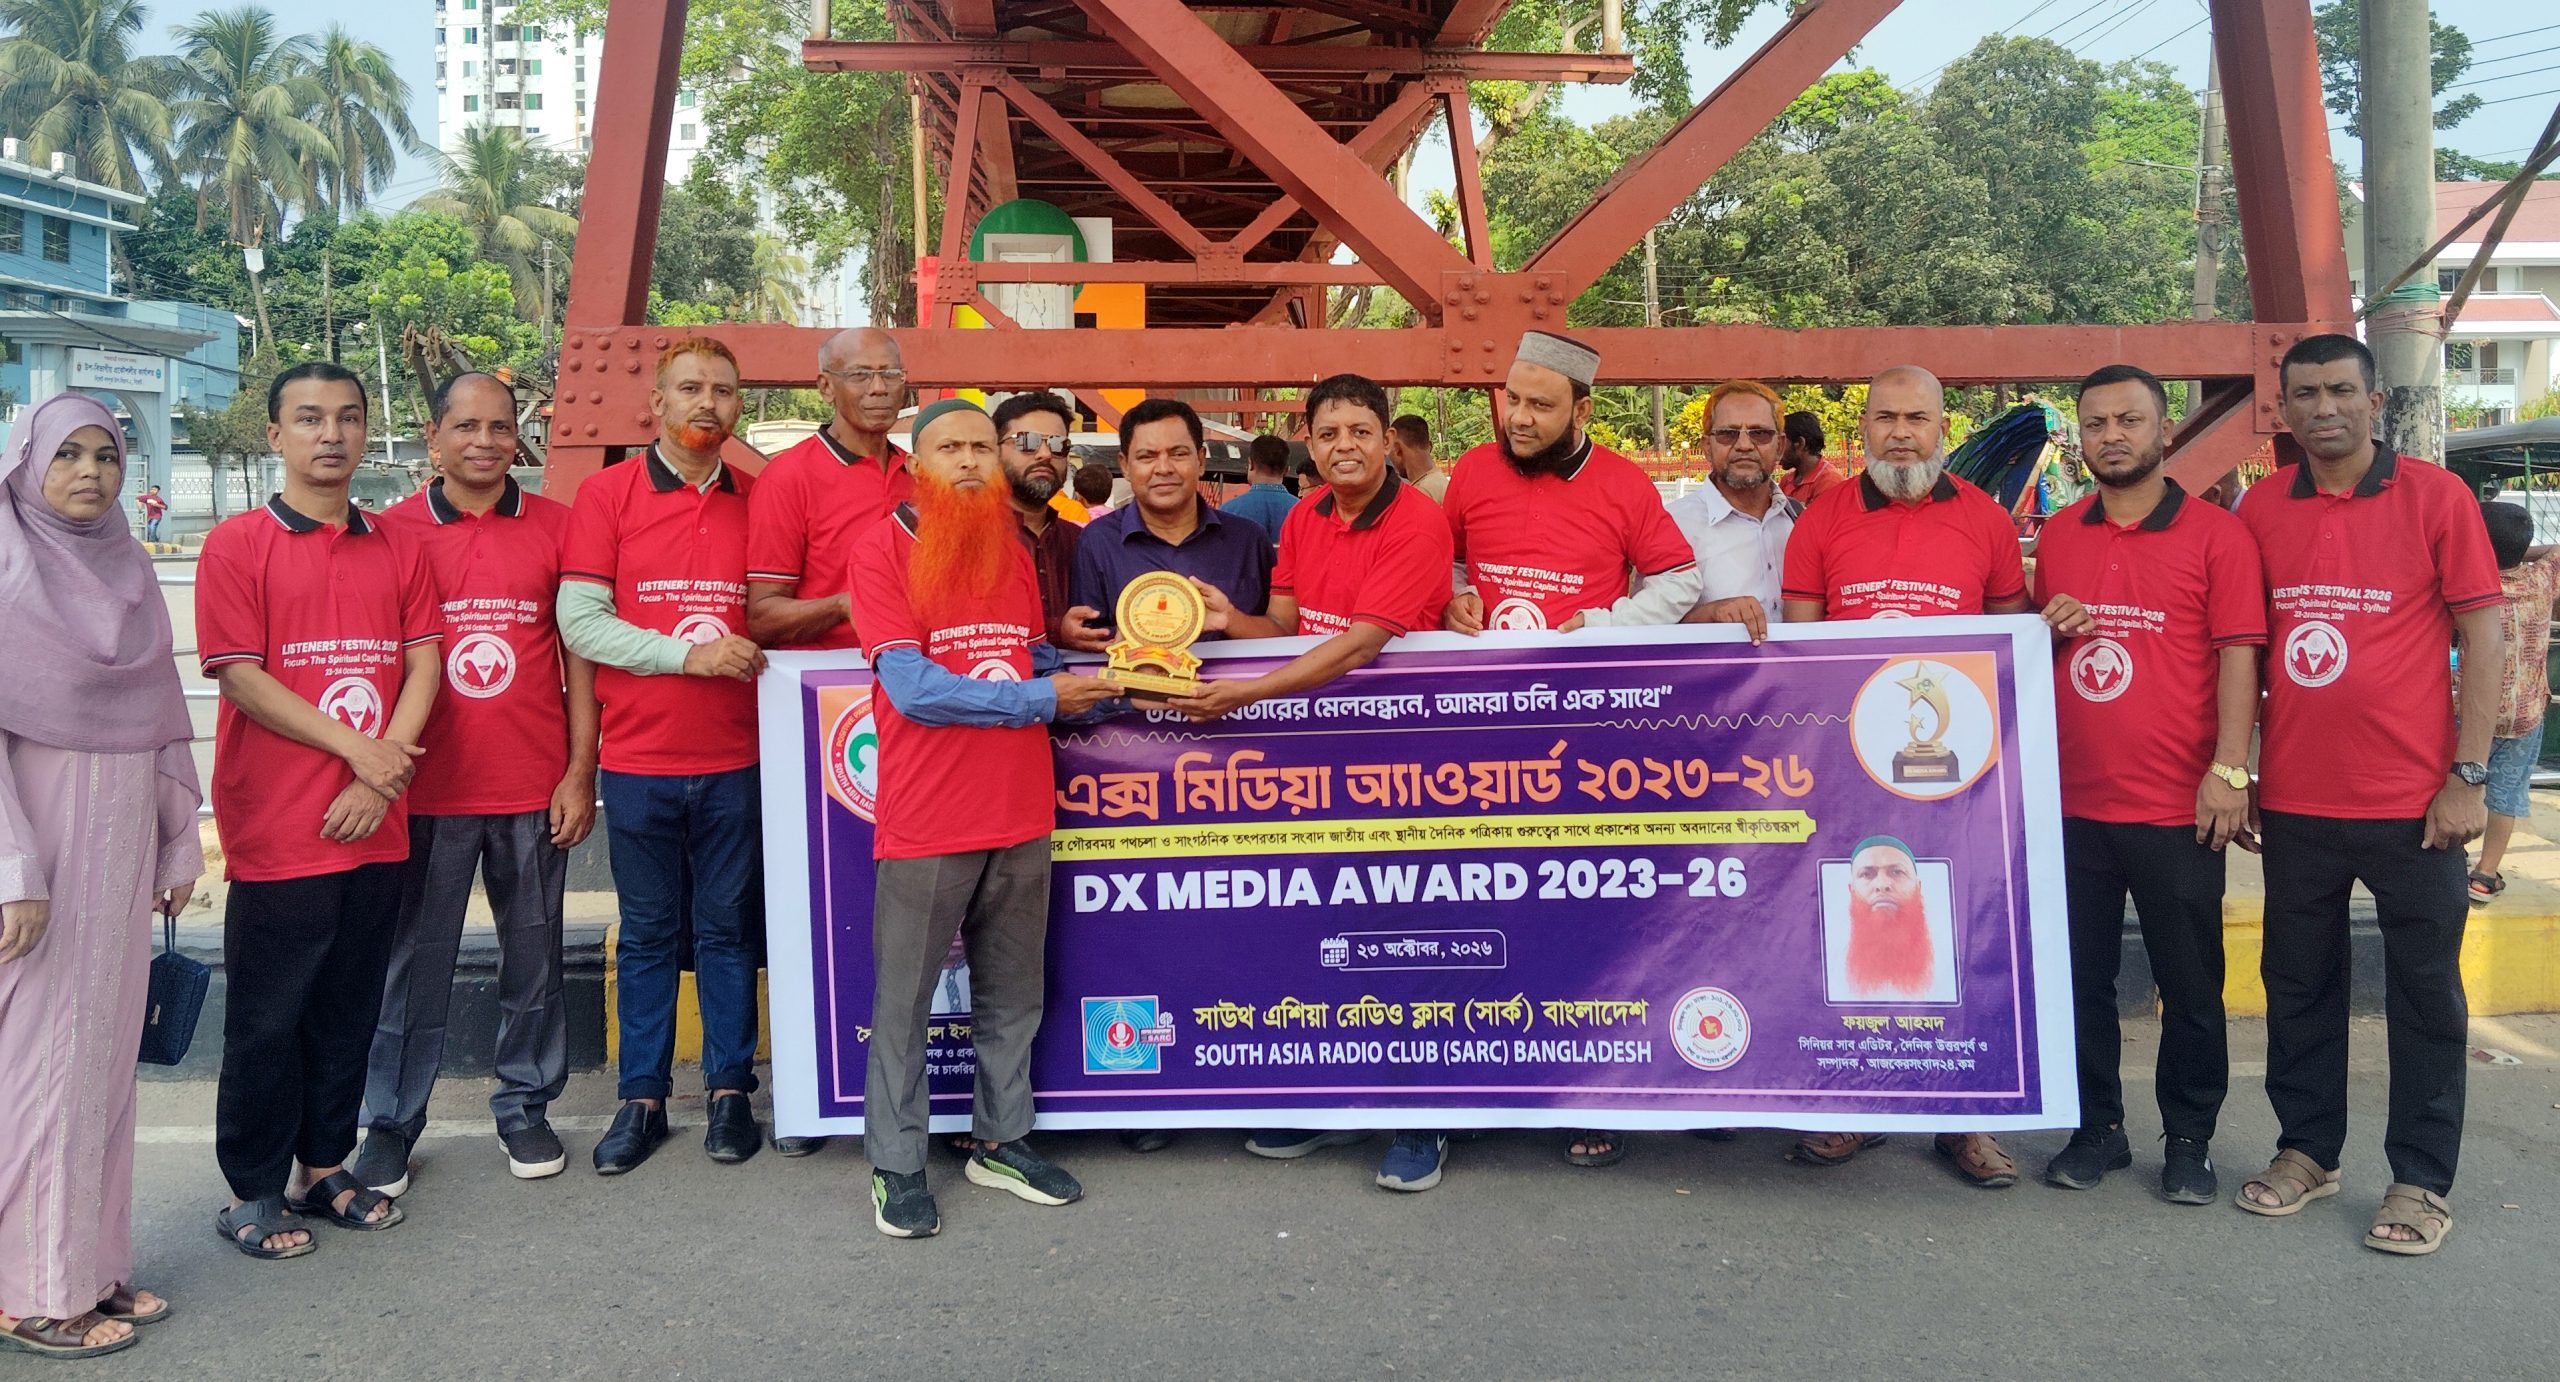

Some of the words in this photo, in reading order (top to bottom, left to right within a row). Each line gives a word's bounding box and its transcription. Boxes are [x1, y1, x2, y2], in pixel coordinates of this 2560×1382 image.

[1503, 577, 1532, 588] Spiritual
[1517, 566, 1561, 582] FESTIVAL
[1561, 573, 1584, 585] 2026
[637, 580, 692, 592] LISTENERS'
[693, 580, 737, 593] FESTIVAL
[1840, 578, 1891, 596] LISTENERS'
[1891, 580, 1938, 593] FESTIVAL
[1938, 585, 1962, 600] 2026
[2314, 585, 2362, 599] FESTIVAL
[2363, 588, 2392, 602] 2026
[472, 598, 516, 610] FESTIVAL
[517, 600, 538, 612] 2026
[638, 594, 664, 603] Focus-
[665, 592, 680, 602] The
[681, 592, 712, 603] Spiritual
[2298, 598, 2330, 609] Spiritual
[2330, 600, 2360, 612] Capital,
[2362, 602, 2390, 614] Sylhet
[446, 614, 460, 624] The
[460, 612, 492, 622] Spiritual
[979, 623, 1016, 635] FESTIVAL
[282, 639, 340, 655] LISTENERS'
[953, 640, 968, 650] The
[968, 638, 996, 650] Spiritual
[284, 658, 309, 668] Focus-
[310, 656, 326, 665] The
[328, 654, 360, 666] Spiritual
[1435, 691, 1508, 716] আমরা
[1512, 683, 1557, 712] চলি
[1562, 688, 1605, 711] এক
[834, 762, 850, 790] SOUTH
[845, 784, 862, 804] ASIA
[1174, 750, 1332, 816] মিডিয়া
[1345, 738, 1568, 811] অ্যাওয়ার্ড
[1067, 836, 1116, 851] গৌরবময়
[1120, 837, 1157, 849] পথচলা
[1161, 838, 1170, 847] ও
[1174, 830, 1229, 848] সাংগঠনিক
[1233, 833, 1287, 846] তৎপরতার
[1291, 832, 1324, 845] সংবাদ
[1330, 826, 1366, 843] জাতীয়
[1368, 832, 1392, 843] এবং
[1394, 824, 1426, 844] স্থানীয়
[1429, 824, 1466, 841] দৈনিক
[1470, 823, 1513, 840] পত্রিকায়
[1517, 825, 1560, 842] গুরুত্বের
[1564, 824, 1590, 837] সাথে
[1594, 822, 1639, 836] প্রকাশের
[1644, 822, 1676, 836] অনন্য
[1680, 822, 1732, 835] অবদানের
[1073, 873, 1148, 913] DX
[1156, 867, 1322, 911] MEDIA
[1329, 862, 1530, 906] AWARD
[1537, 857, 1748, 900] 2023-26
[1357, 942, 1379, 959] ২৩
[1450, 940, 1493, 958] ২০২৬
[1192, 998, 1256, 1031] সাউথ
[1262, 996, 1330, 1030] এশিয়া
[1336, 994, 1404, 1028] রেডিও
[1410, 1000, 1456, 1029] ক্লাব
[1464, 992, 1534, 1034] (সার্ক)
[1540, 998, 1650, 1028] বাংলাদেশ
[1841, 1016, 1891, 1034] ফয়জুল
[1894, 1015, 1946, 1032] আহমদ
[946, 1048, 954, 1058] ও
[1194, 1044, 1264, 1067] SOUTH
[1267, 1042, 1315, 1066] ASIA
[1318, 1040, 1384, 1065] RADIO
[1386, 1040, 1439, 1064] CLUB
[1443, 1040, 1509, 1066] (SARC)
[1514, 1040, 1652, 1064] BANGLADESH
[1798, 1036, 1834, 1052] সিনিয়র
[1836, 1038, 1855, 1052] সাব
[1898, 1036, 1932, 1052] দৈনিক
[1935, 1036, 1976, 1055] উত্তরপূর্ব
[1978, 1041, 1988, 1052] ও
